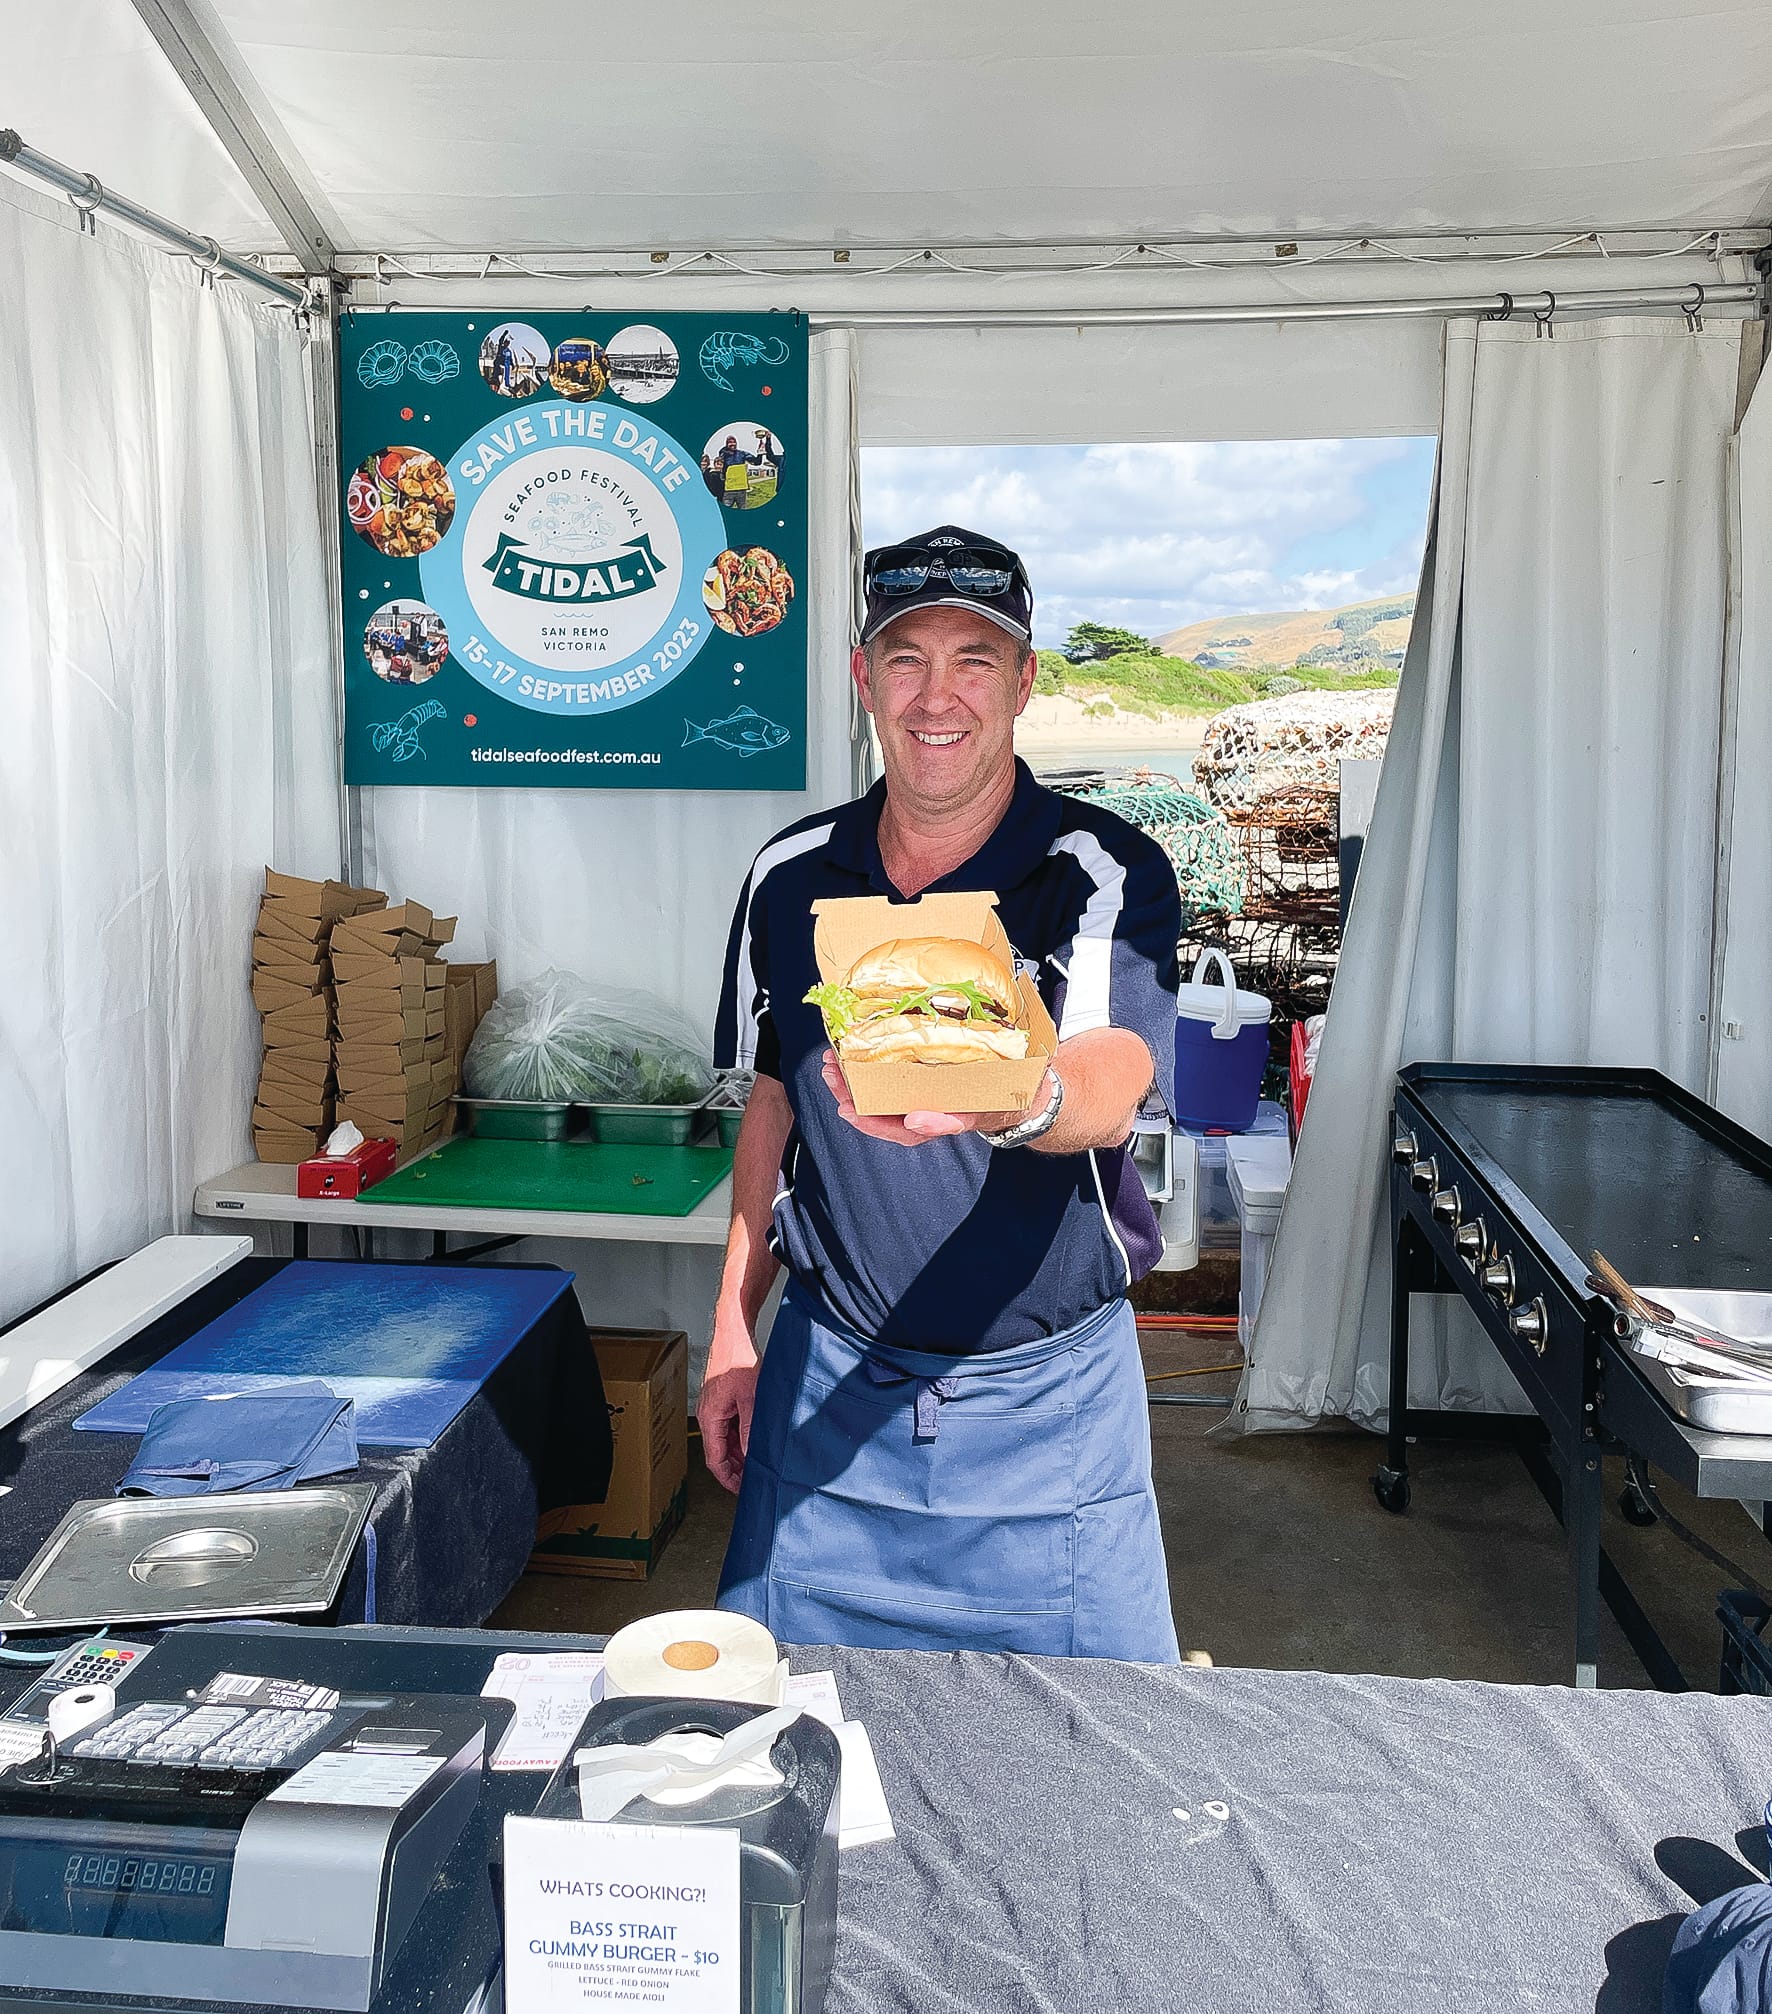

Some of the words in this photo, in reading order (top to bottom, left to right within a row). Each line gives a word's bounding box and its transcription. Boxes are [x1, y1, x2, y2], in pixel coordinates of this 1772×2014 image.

[459, 418, 538, 486] SAVE
[541, 408, 605, 440] THE
[611, 419, 691, 494] DATE
[503, 469, 572, 524] SEAFOOD
[580, 469, 644, 528] FESTIVAL
[517, 564, 635, 597] TIDAL
[541, 626, 568, 637] SAN
[572, 626, 610, 637] REMO
[542, 641, 607, 652] VICTORIA
[461, 635, 517, 685] 15-17
[518, 669, 656, 704] SEPTEMBER
[652, 617, 701, 673] 2023
[470, 747, 662, 766] tidalseafoodfest.com.au
[539, 1879, 604, 1897] WHATS
[609, 1883, 707, 1903] COOKING?!
[570, 1920, 613, 1937] BASS
[619, 1923, 678, 1941] STRAIT
[529, 1939, 599, 1958] GUMMY
[603, 1944, 677, 1962] BURGER
[693, 1949, 719, 1965] $10
[547, 1960, 582, 1970] GRILLED
[583, 1963, 605, 1972] BASS
[606, 1964, 636, 1974] STRAIT
[637, 1966, 673, 1976] GUMMY
[675, 1969, 701, 1978] FLAKE
[578, 1976, 614, 1986] LETTUCE
[621, 1978, 638, 1988] RED
[640, 1979, 670, 1989] ONION
[583, 1989, 613, 1999] HOUSE
[614, 1991, 641, 2000] MADE
[642, 1993, 665, 2002] AIOLI
